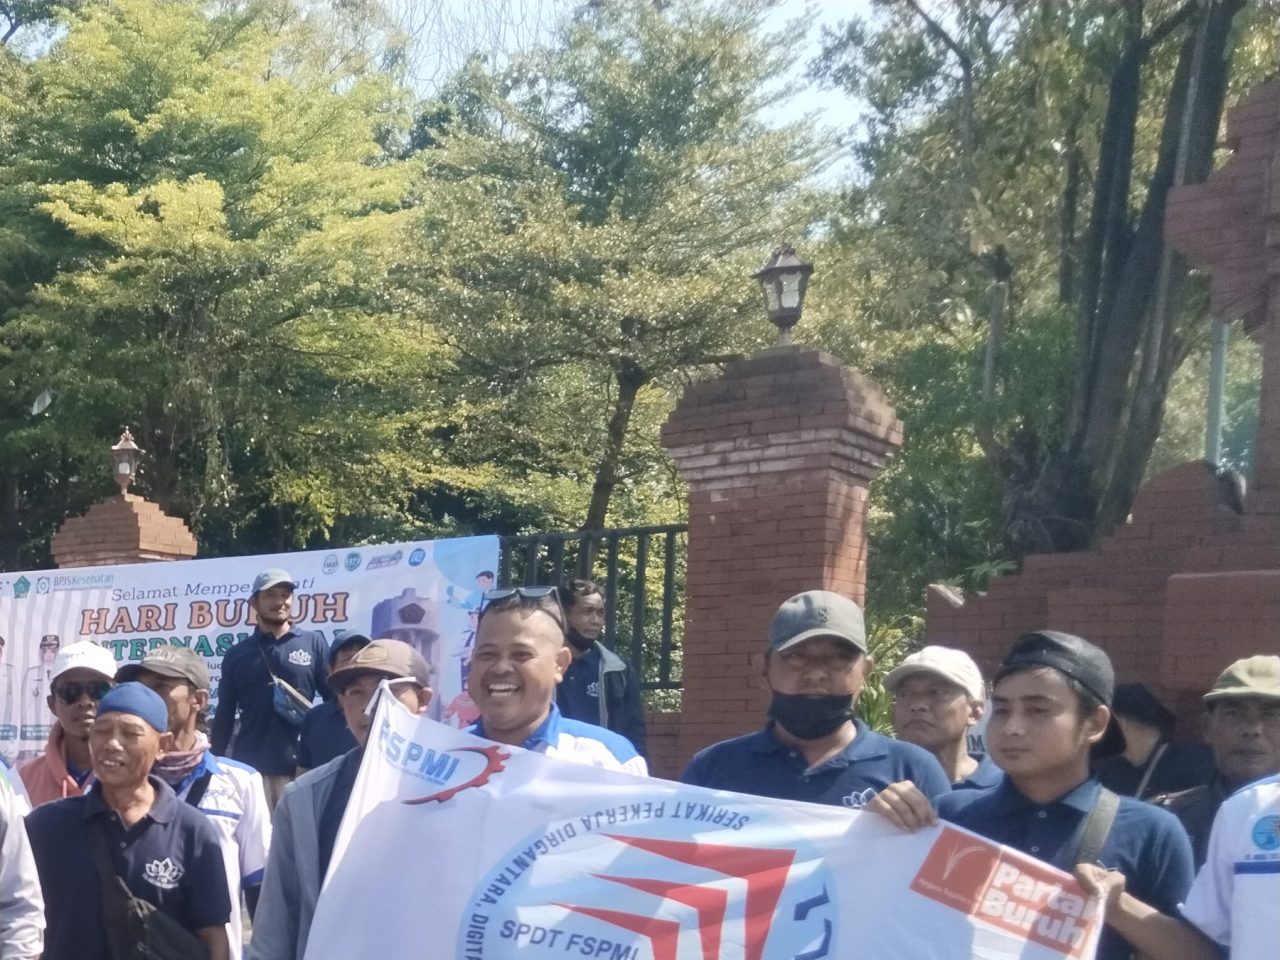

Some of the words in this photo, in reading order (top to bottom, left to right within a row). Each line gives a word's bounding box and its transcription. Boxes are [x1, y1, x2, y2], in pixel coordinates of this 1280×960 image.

[112, 586, 178, 601] Selamat
[79, 602, 179, 635] HARI
[378, 718, 460, 781] FSPMI
[581, 801, 665, 831] PEKERJA
[672, 801, 750, 831] SERIKAT
[992, 861, 1100, 919] Partai
[500, 919, 563, 948] SPDT
[980, 887, 1087, 949] Buruh
